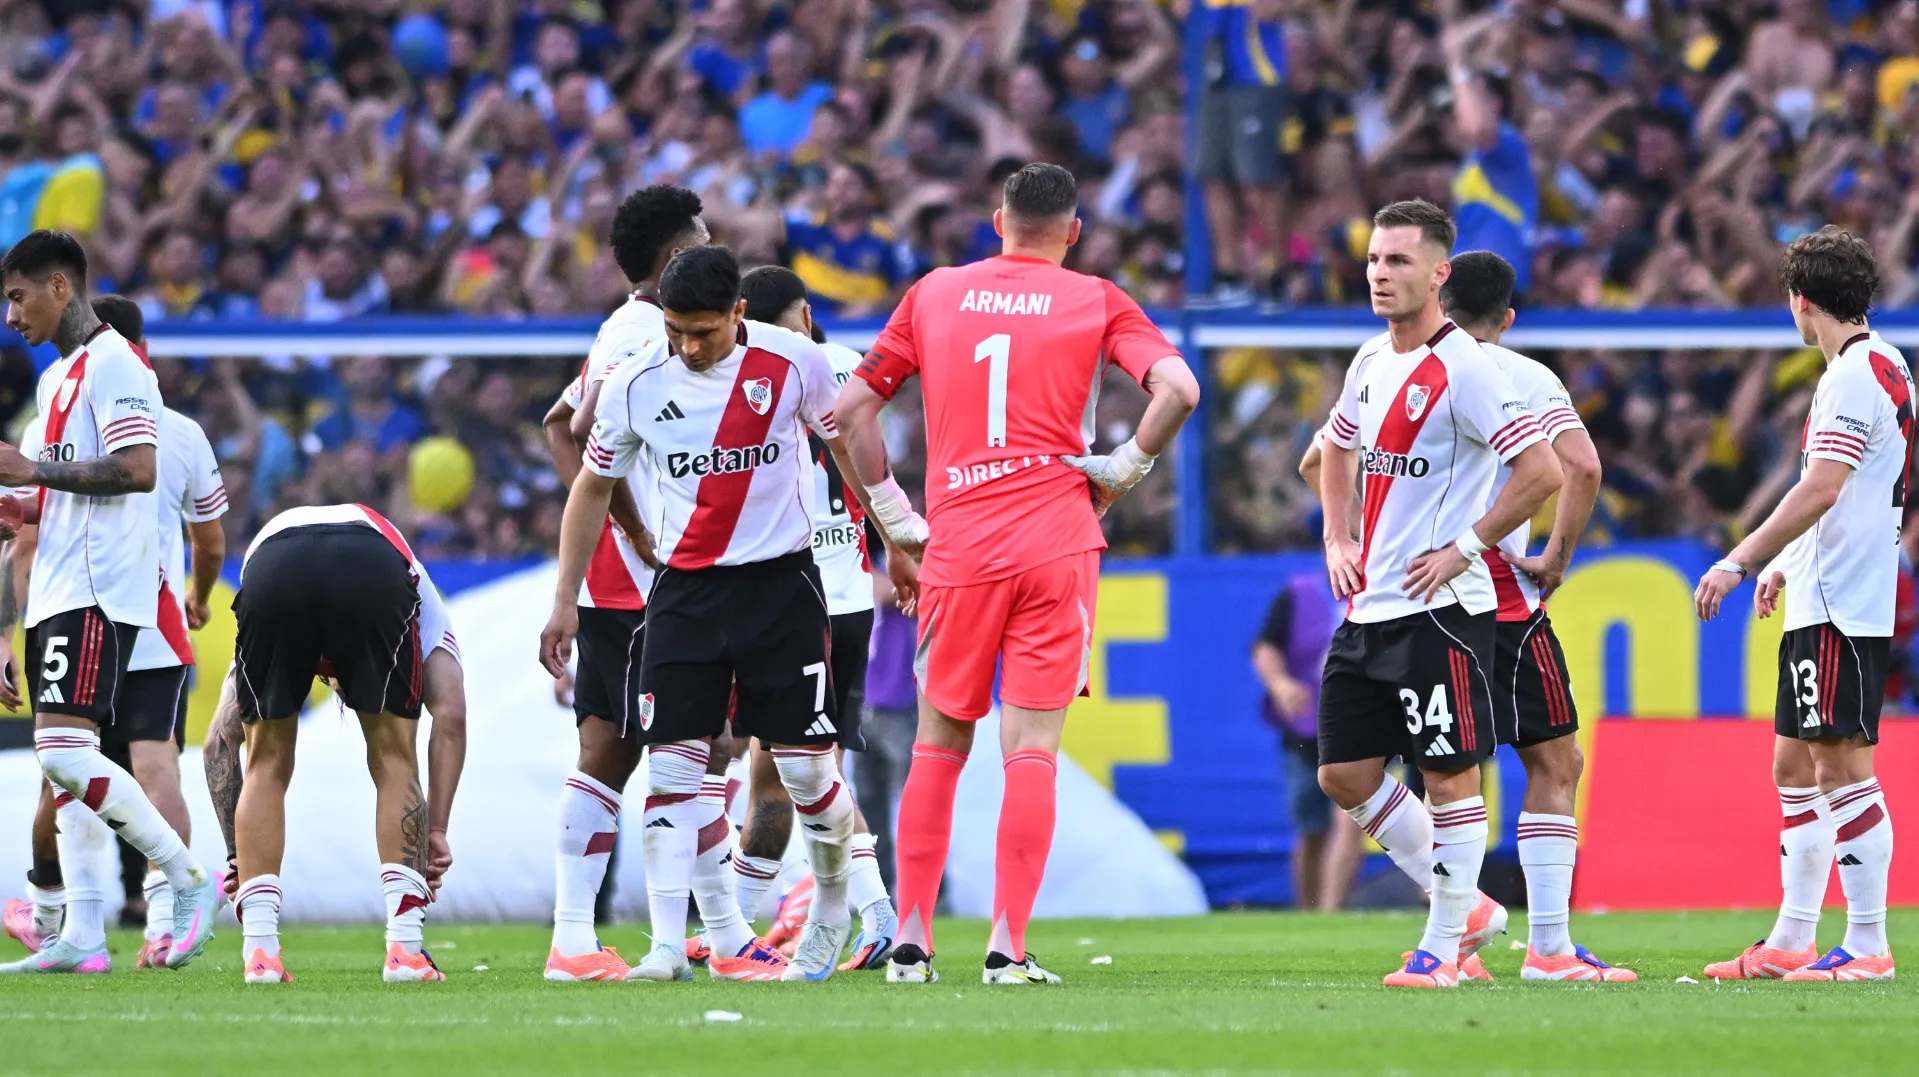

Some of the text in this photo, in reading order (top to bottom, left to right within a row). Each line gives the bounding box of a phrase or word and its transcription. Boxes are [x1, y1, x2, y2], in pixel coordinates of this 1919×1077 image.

[960, 290, 1052, 316] ARMANI
[974, 333, 1011, 448] 1
[1835, 415, 1871, 430] ASSIST
[666, 441, 780, 479] Betano
[43, 636, 69, 681] 5
[803, 661, 826, 712] 7
[1399, 684, 1453, 735] 34
